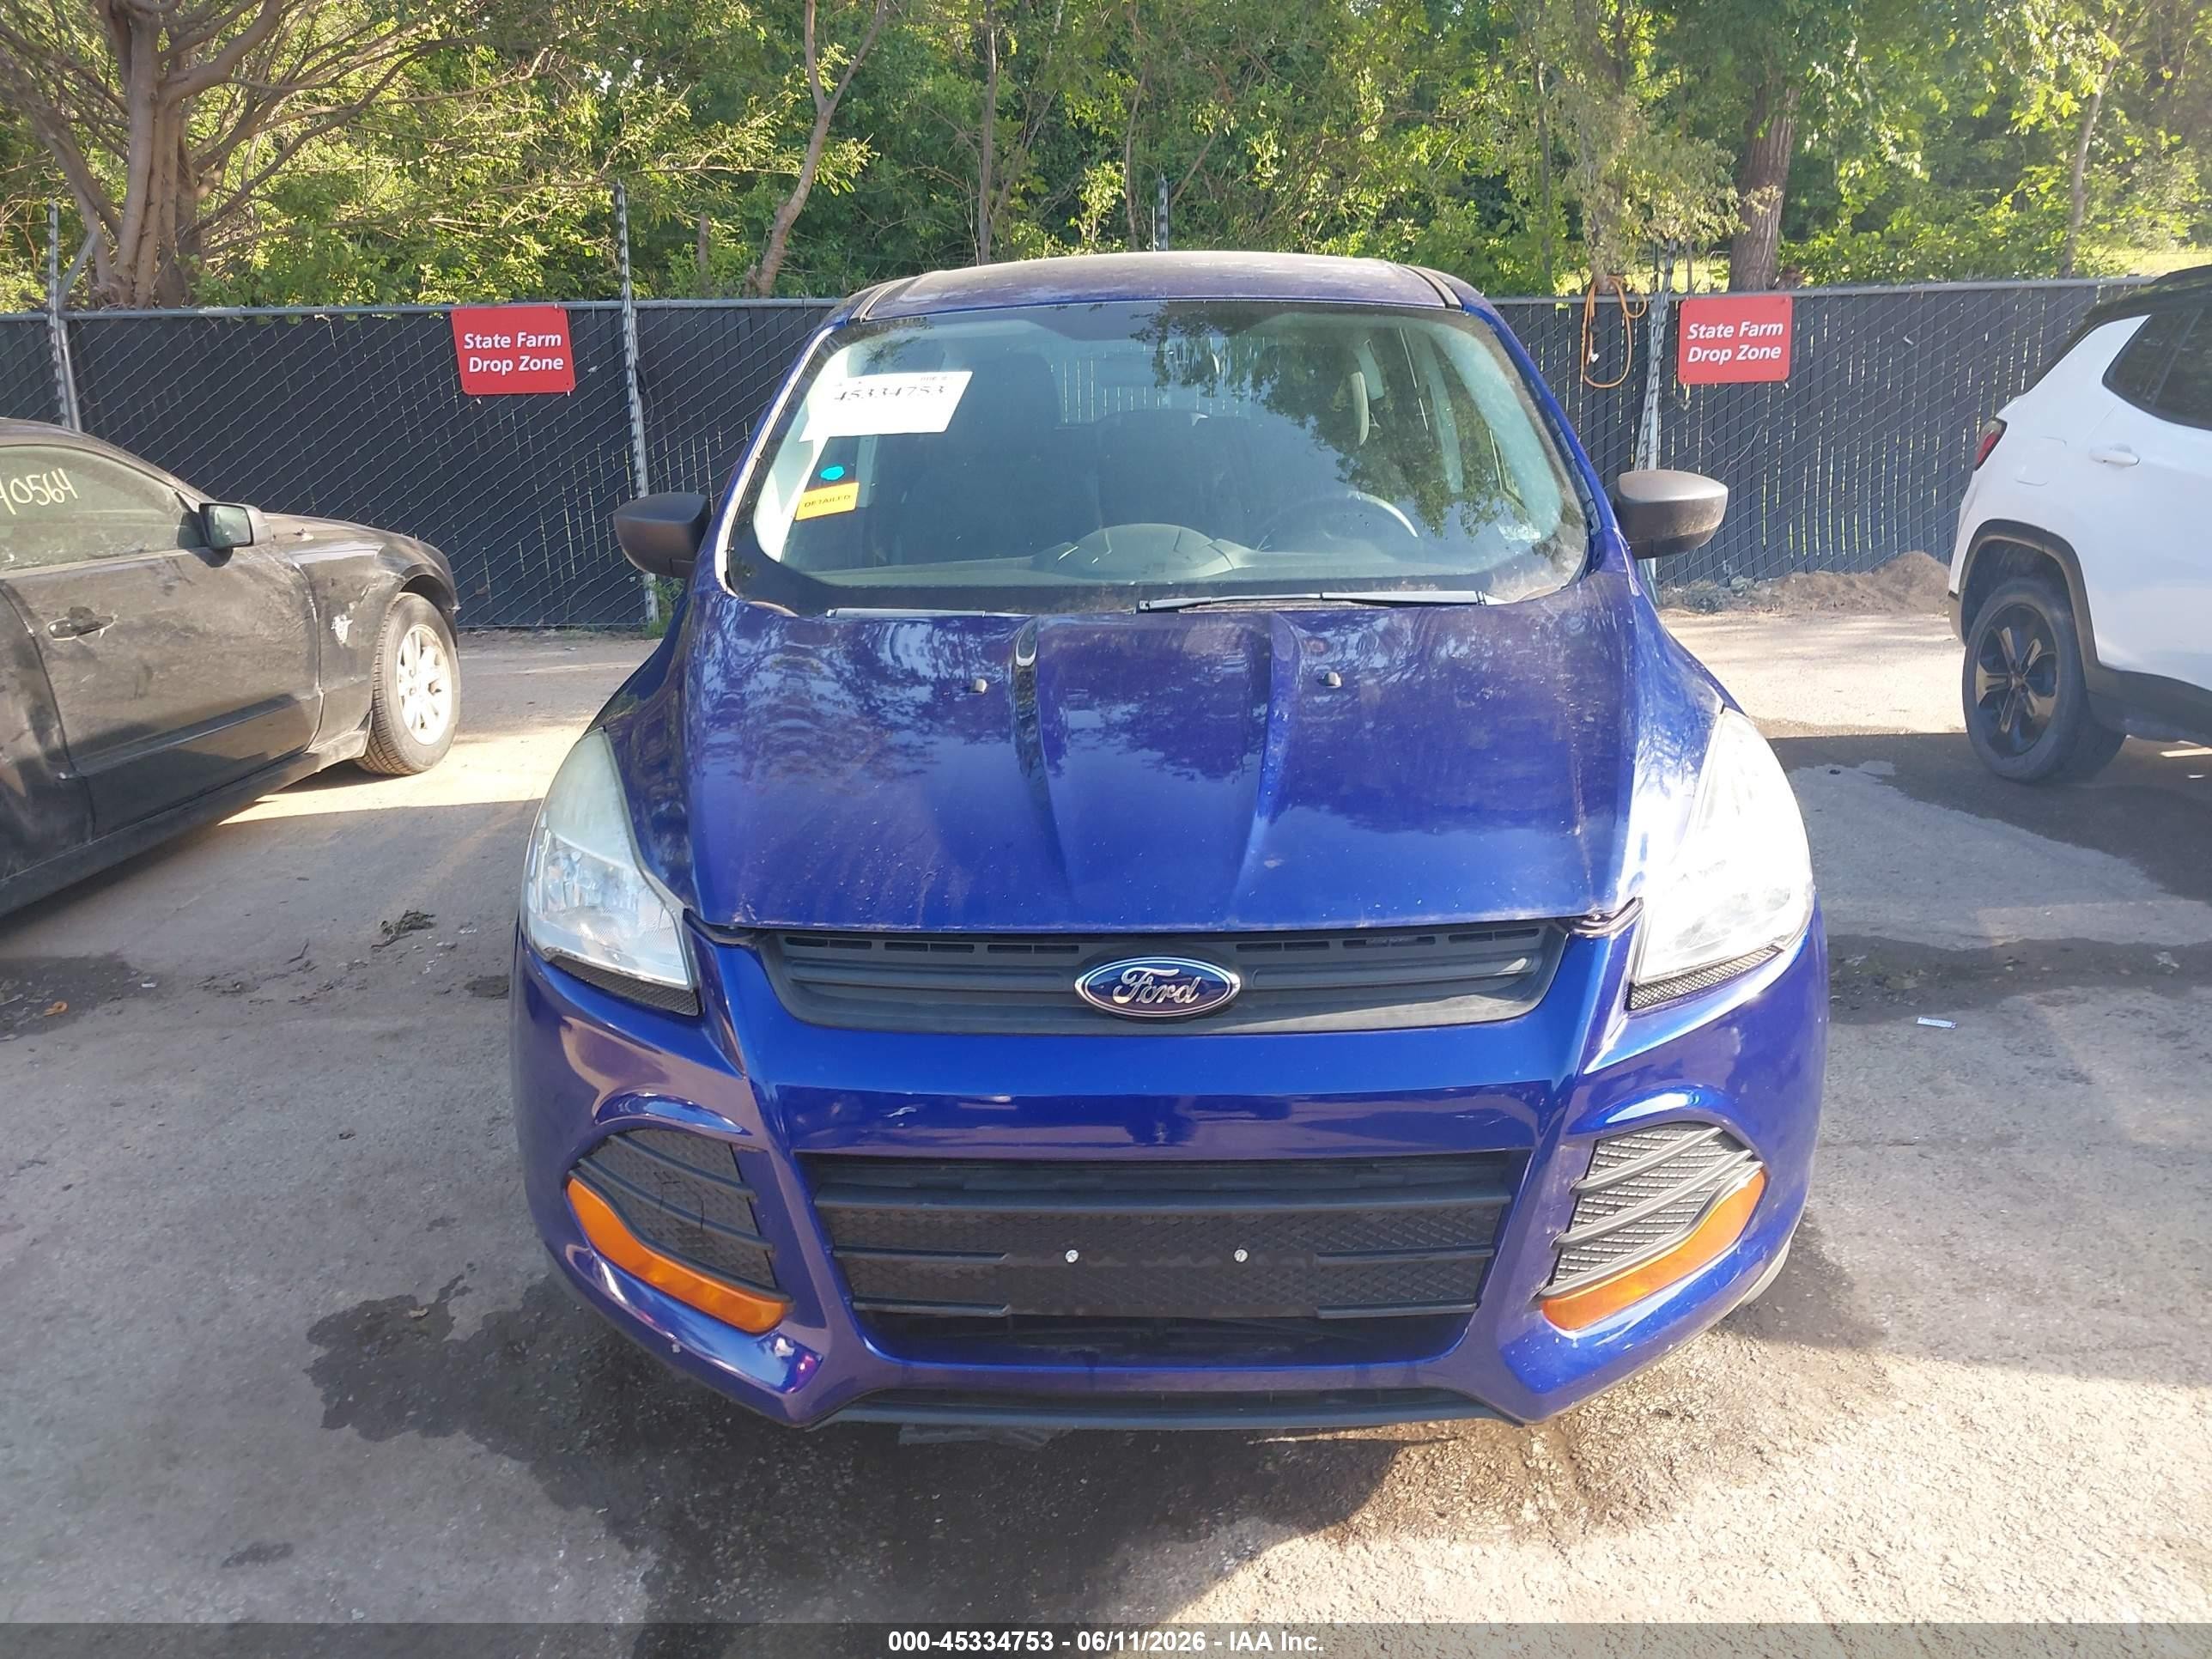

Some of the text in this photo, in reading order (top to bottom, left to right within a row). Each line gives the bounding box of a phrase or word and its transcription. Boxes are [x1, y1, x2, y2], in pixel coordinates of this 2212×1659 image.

[1686, 321, 1784, 339] State Farm
[464, 331, 562, 349] State Farm
[1687, 344, 1782, 365] Drop Zone
[469, 356, 564, 375] Drop Zone
[1112, 967, 1202, 1004] Ford
